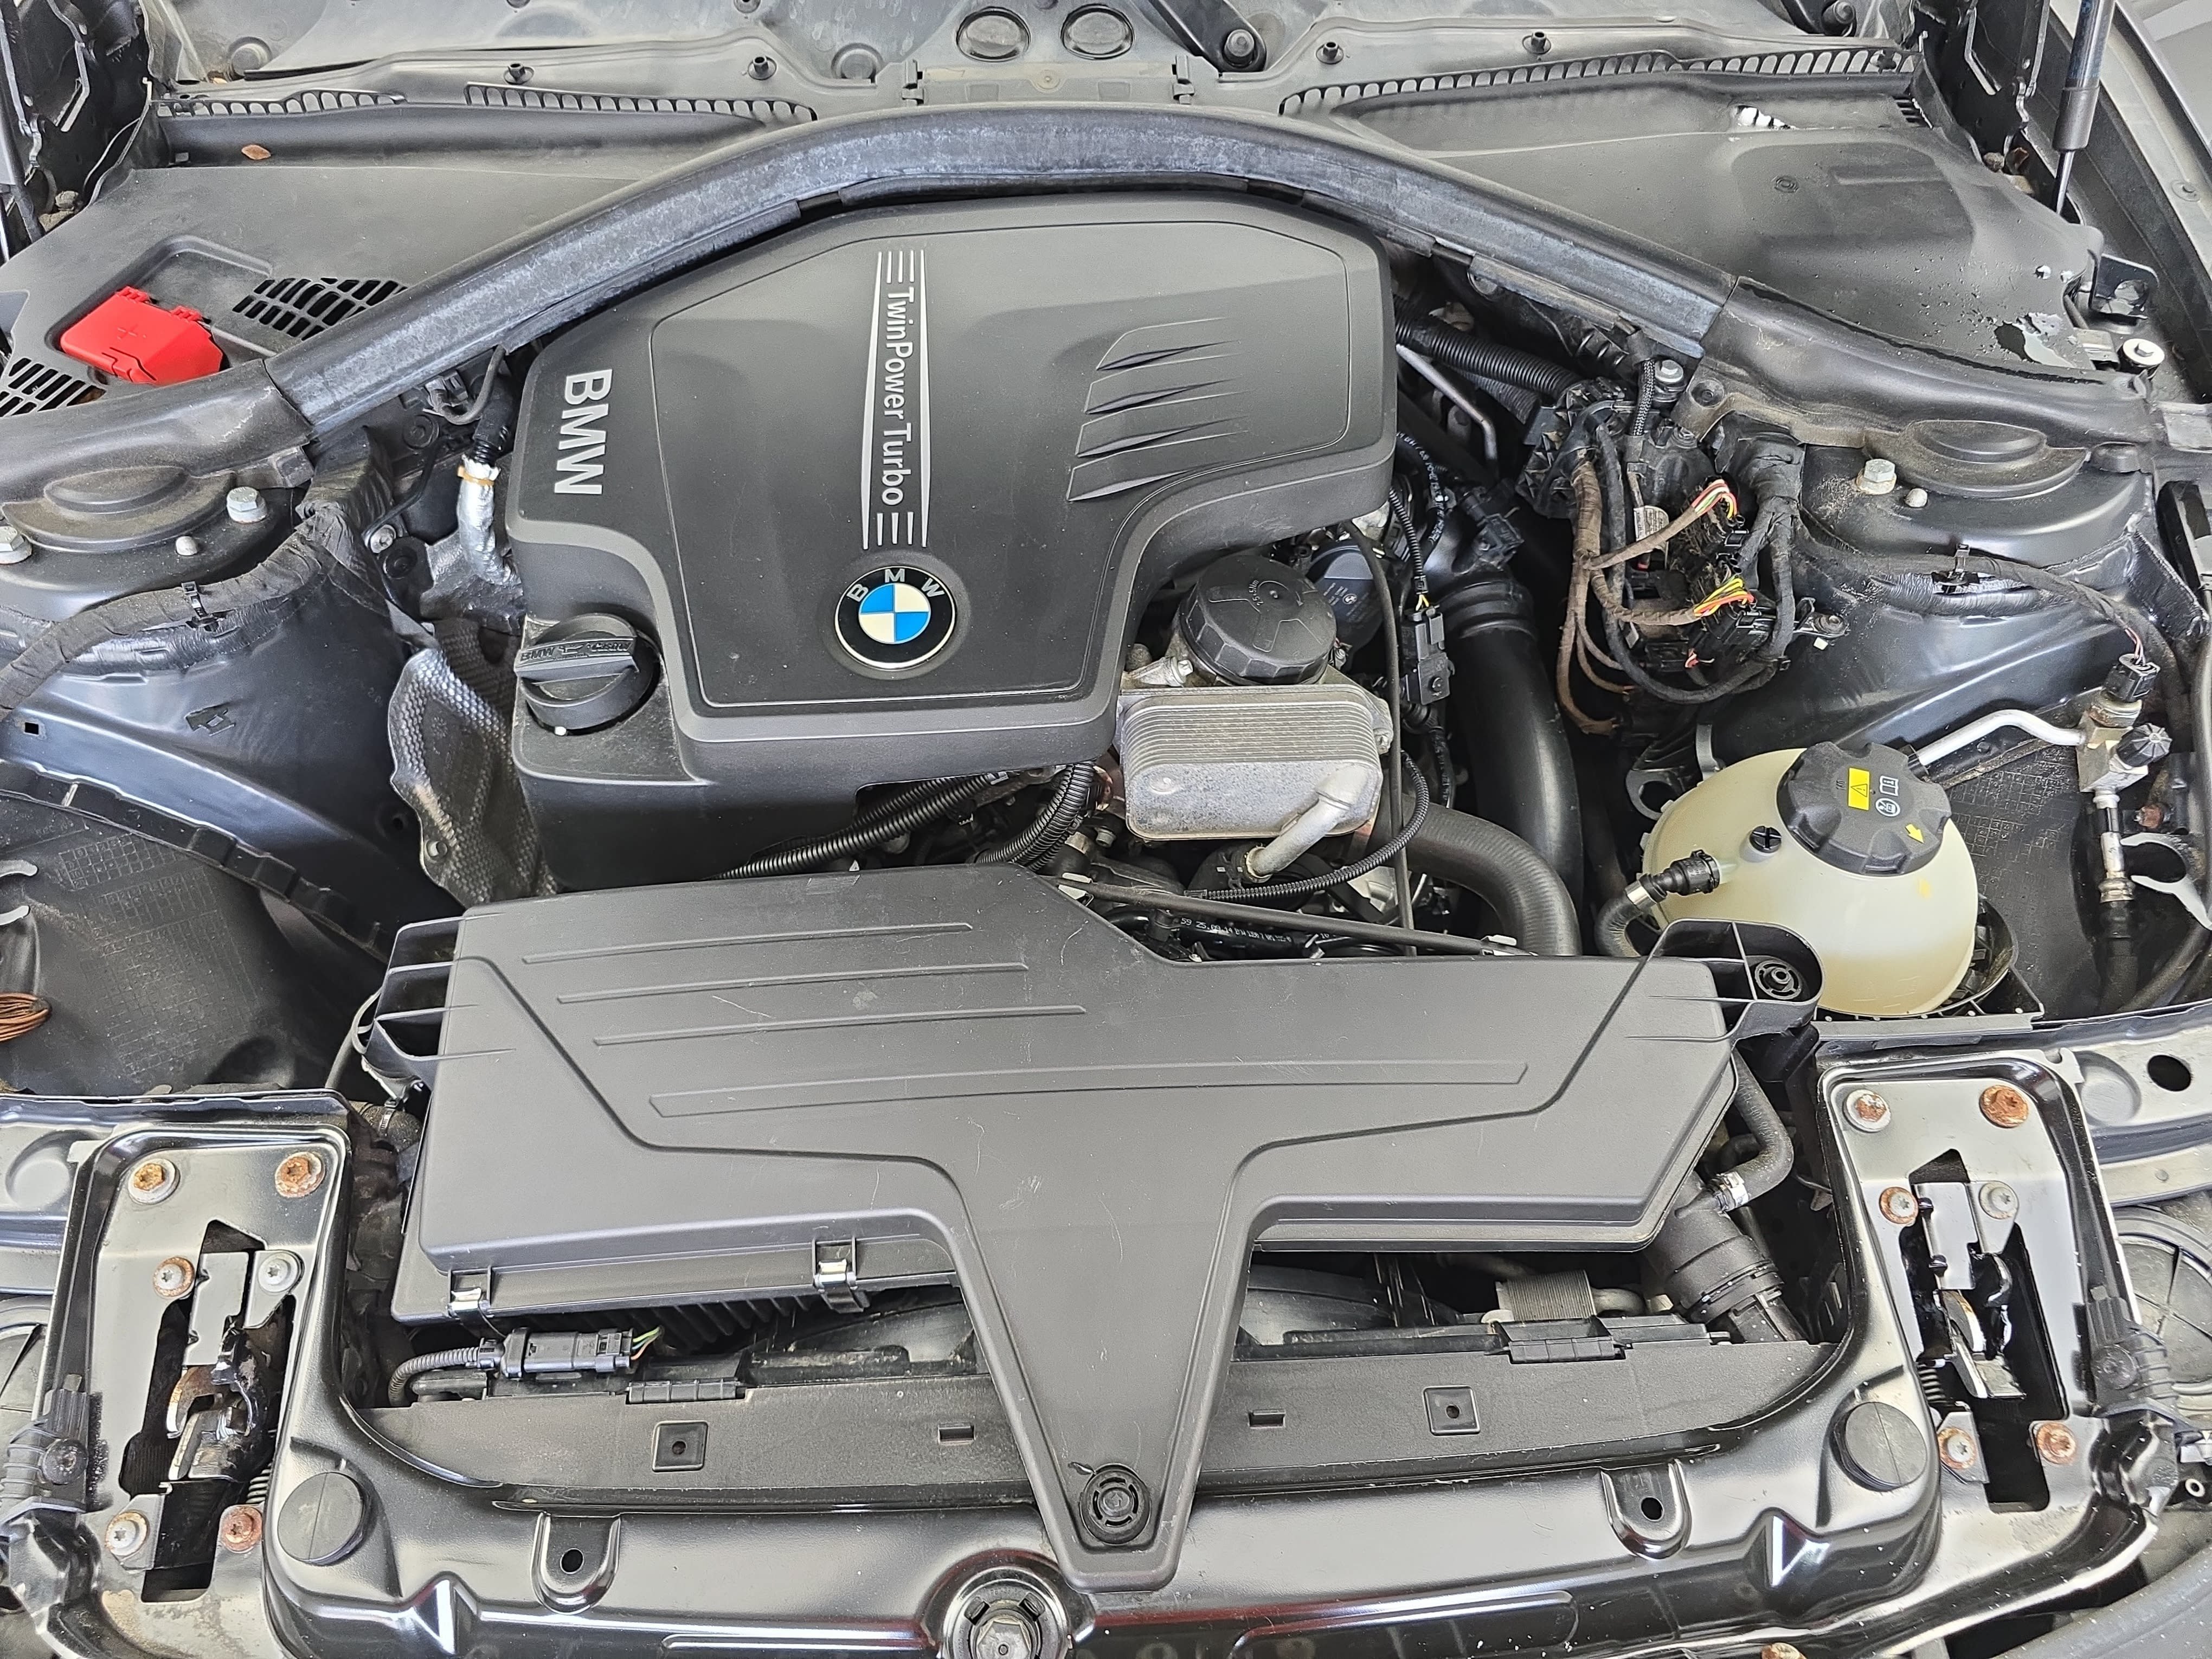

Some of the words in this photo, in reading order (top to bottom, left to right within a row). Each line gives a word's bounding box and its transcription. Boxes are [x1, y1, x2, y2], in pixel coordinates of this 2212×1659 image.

[883, 287, 915, 420] TwinPower
[554, 369, 613, 494] BMW
[882, 422, 912, 506] Turbo
[846, 568, 945, 602] BMW
[520, 646, 555, 661] BMW
